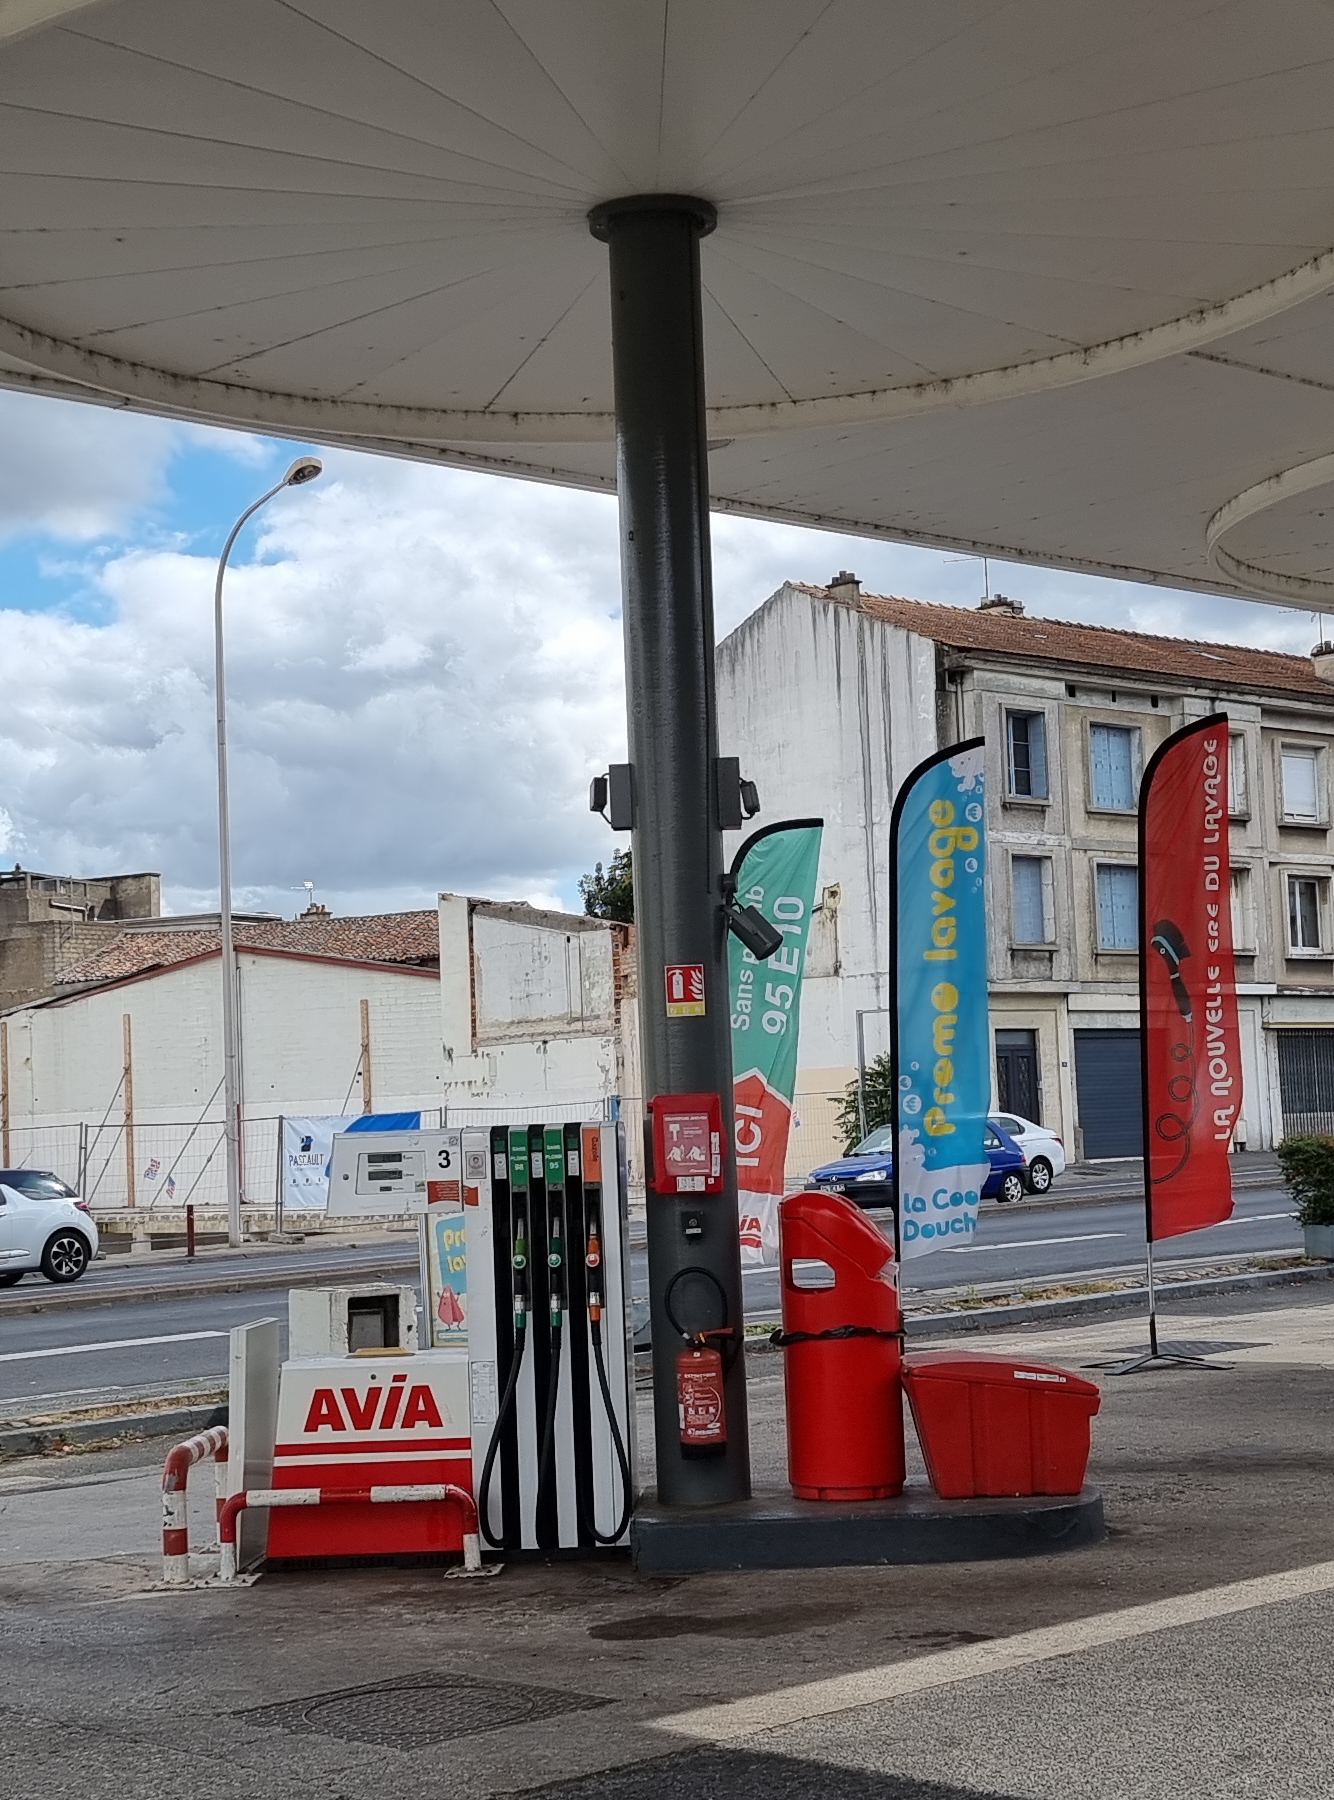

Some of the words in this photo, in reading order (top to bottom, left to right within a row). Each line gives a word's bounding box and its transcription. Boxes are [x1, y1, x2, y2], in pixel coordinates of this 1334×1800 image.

[1203, 738, 1223, 844] LAVAGE
[923, 798, 979, 961] lavage
[1203, 855, 1220, 891] DU
[730, 969, 754, 1031] Sans
[762, 982, 794, 1034] 95
[1205, 965, 1233, 1096] NOUVELLE
[923, 981, 959, 1136] Promo
[735, 1103, 763, 1167] ICI
[1214, 1104, 1235, 1140] LA
[438, 1149, 452, 1169] 3
[903, 1192, 927, 1214] la
[932, 1187, 979, 1210] Coo
[303, 1373, 444, 1433] AVIA
